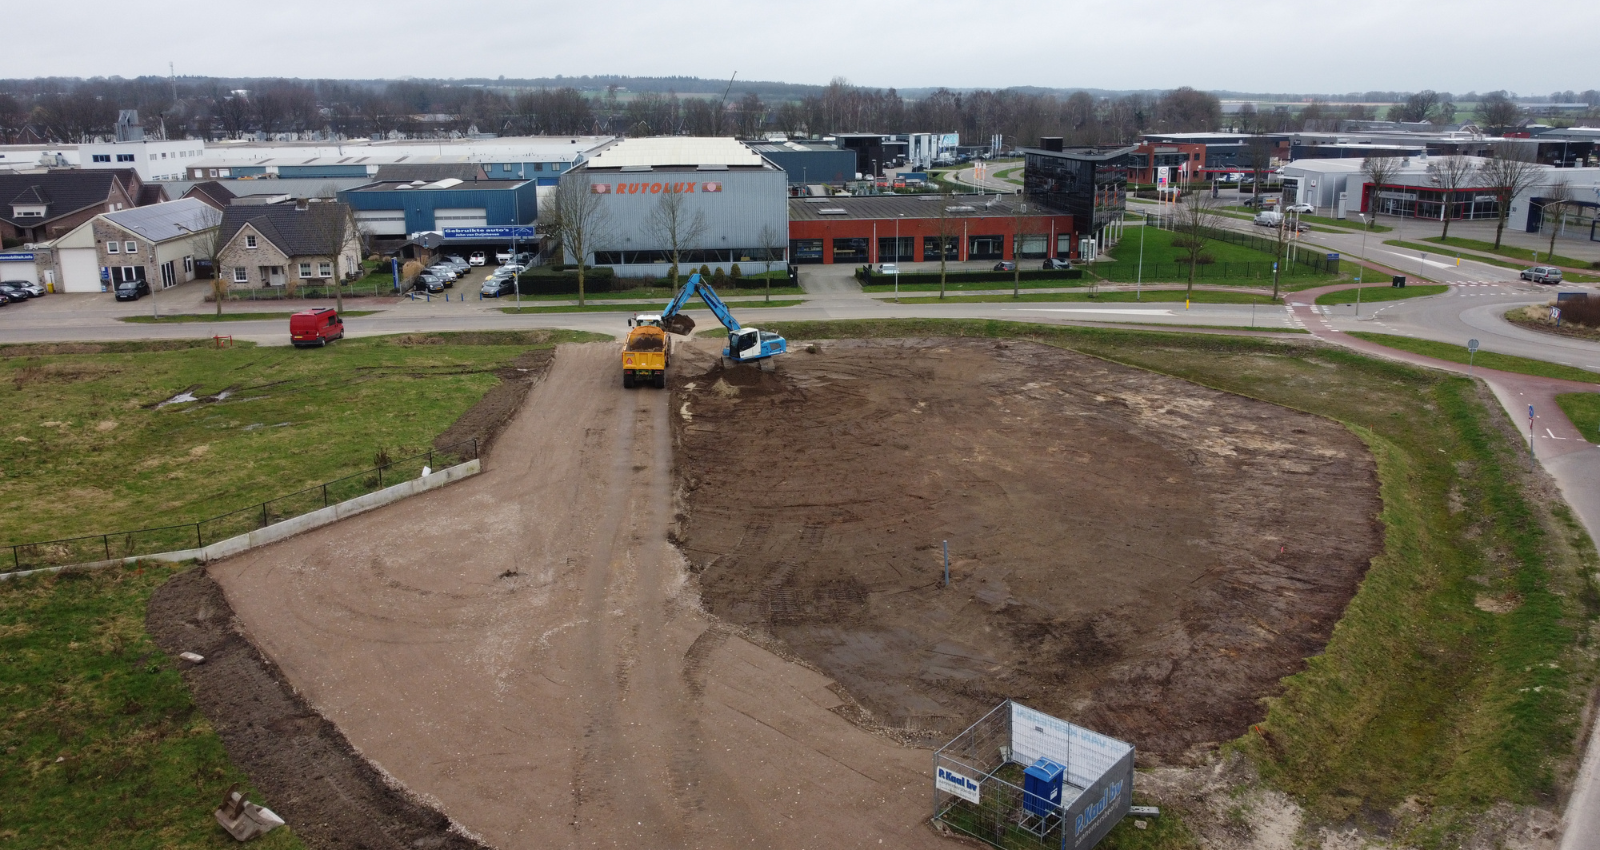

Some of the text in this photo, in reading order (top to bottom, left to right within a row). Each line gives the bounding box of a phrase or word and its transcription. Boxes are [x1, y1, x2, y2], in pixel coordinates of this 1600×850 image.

[616, 182, 697, 194] RUTOLUX
[966, 778, 978, 792] bv
[1108, 779, 1124, 804] bv
